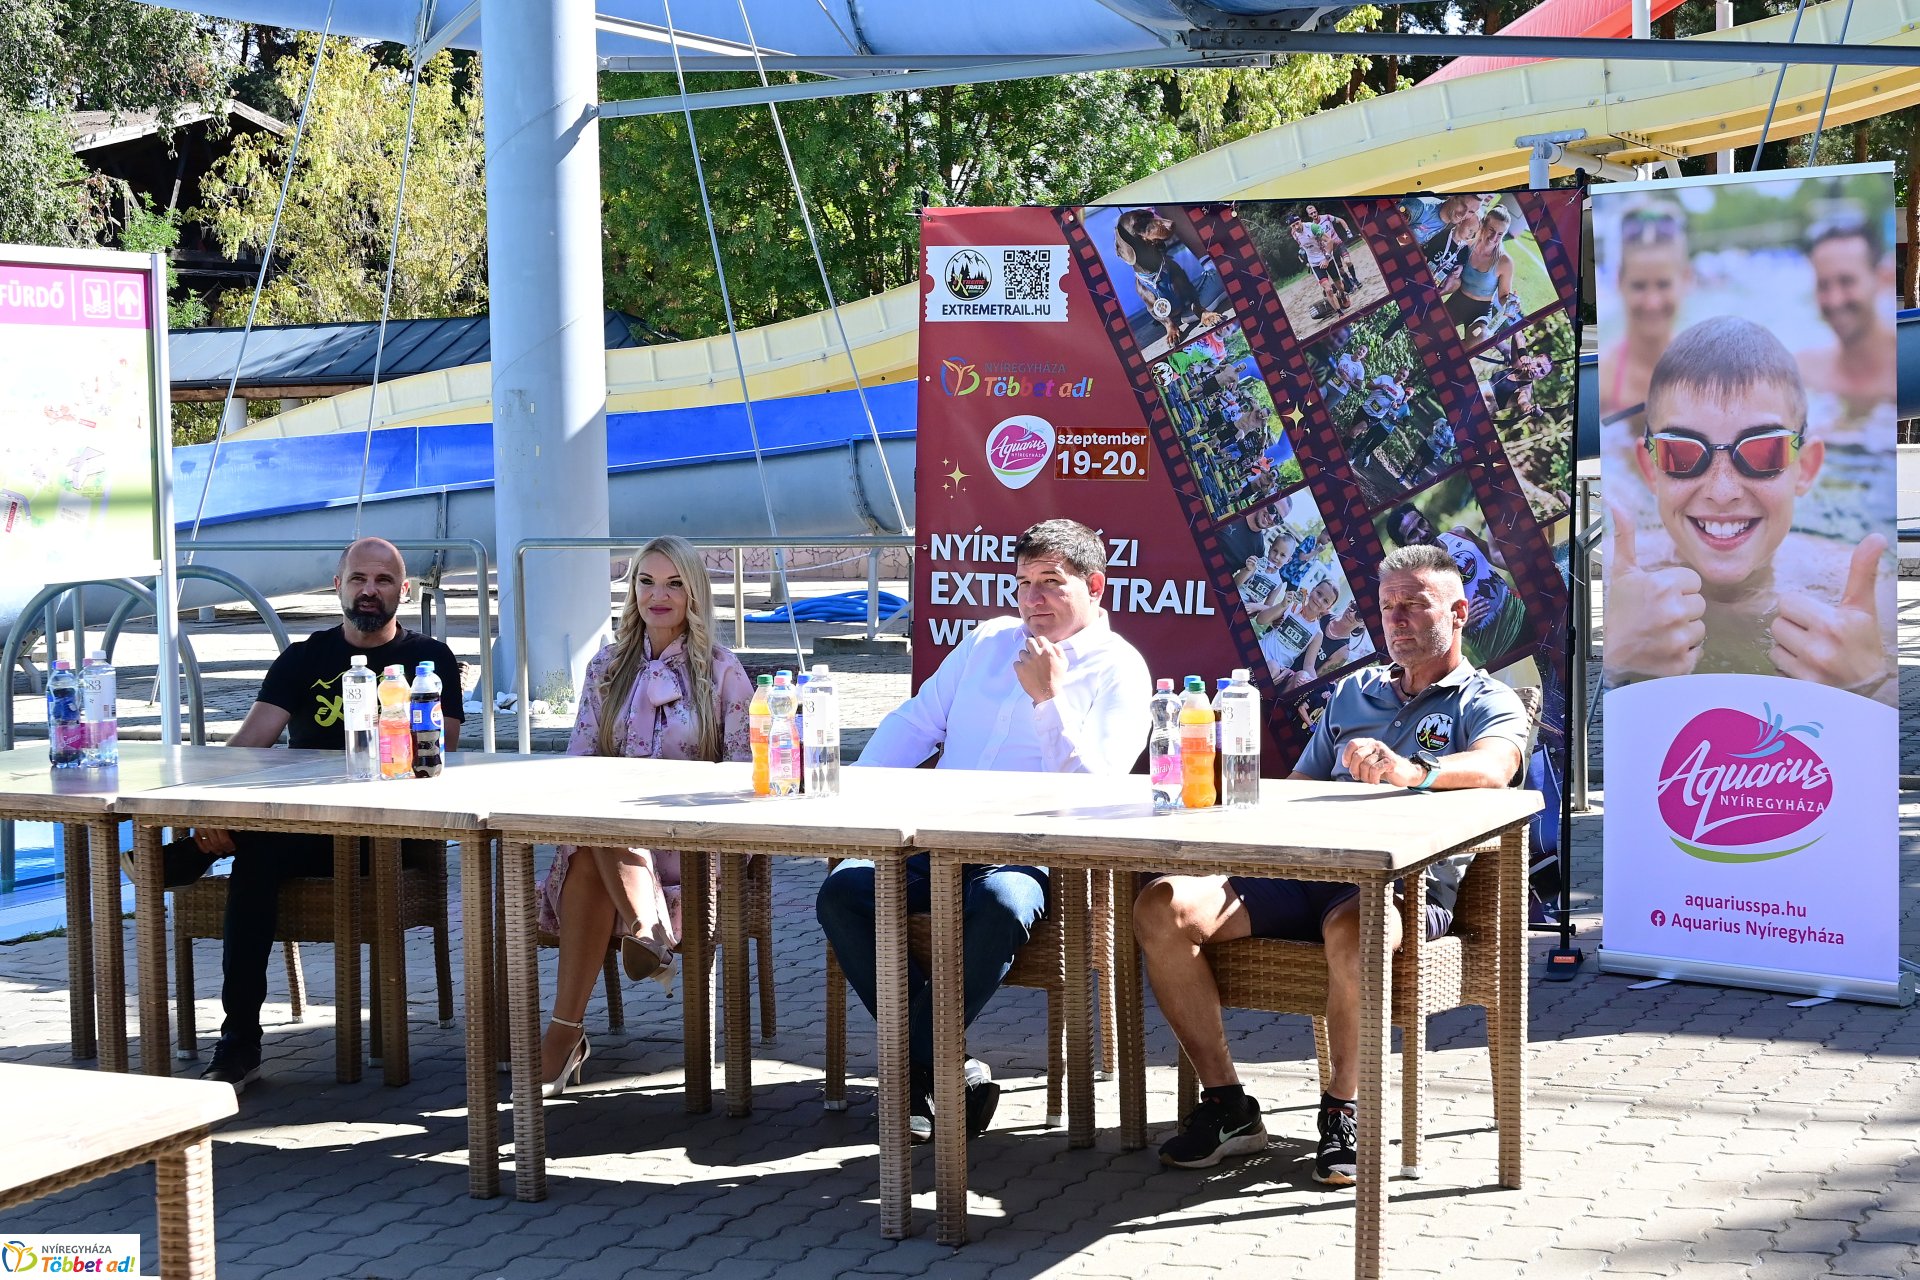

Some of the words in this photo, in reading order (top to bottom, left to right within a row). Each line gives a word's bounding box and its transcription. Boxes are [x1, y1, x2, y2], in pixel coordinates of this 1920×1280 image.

[0, 279, 65, 308] FÜRDŐ
[942, 304, 1051, 316] EXTREMETRAIL.HU
[984, 361, 1066, 374] NYÍREGYHÁZA
[984, 376, 1054, 398] Többet
[1058, 376, 1093, 398] ad!
[1057, 431, 1147, 447] szeptember
[991, 435, 1046, 469] Aquarius
[1057, 450, 1146, 476] 19-20.
[1106, 577, 1215, 616] TRAIL
[1285, 627, 1300, 641] 513
[1658, 739, 1830, 842] Aquarius
[1720, 793, 1825, 813] NYÍREGYHÁZA
[1684, 894, 1807, 918] aquariusspa.hu
[1671, 913, 1741, 934] Aquarius
[1745, 920, 1845, 945] Nyíregyháza
